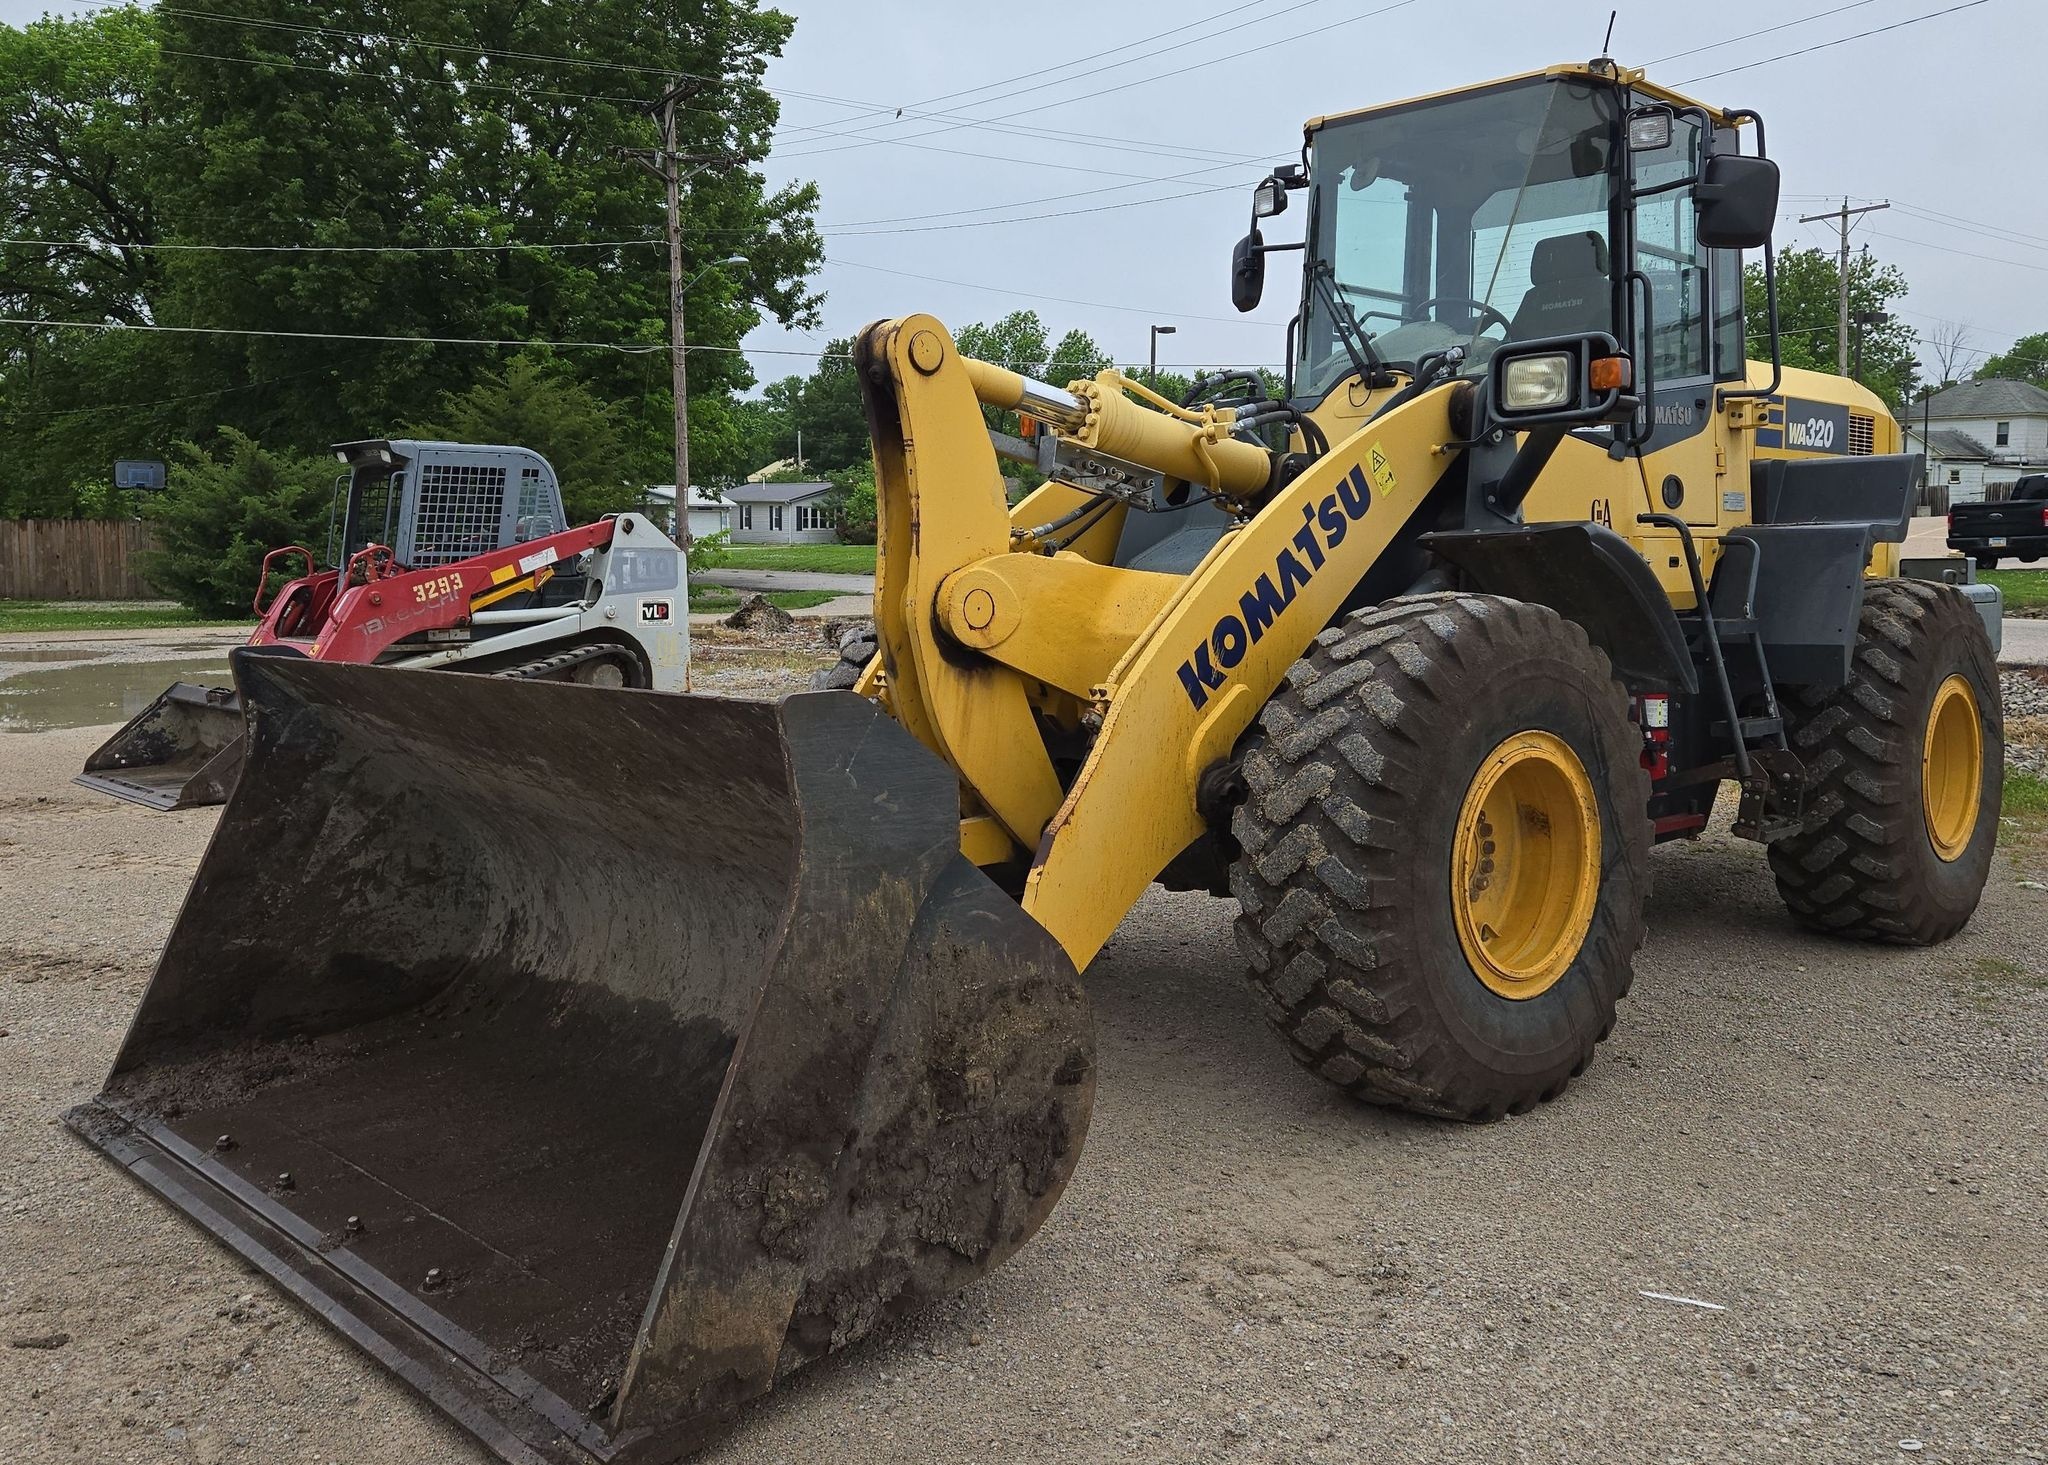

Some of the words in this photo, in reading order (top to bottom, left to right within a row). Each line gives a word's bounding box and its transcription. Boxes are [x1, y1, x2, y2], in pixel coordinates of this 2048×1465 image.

[1638, 403, 1692, 425] KMATSU
[1789, 418, 1834, 448] WA320
[412, 572, 464, 602] 3293
[1177, 464, 1372, 711] KOMATSU
